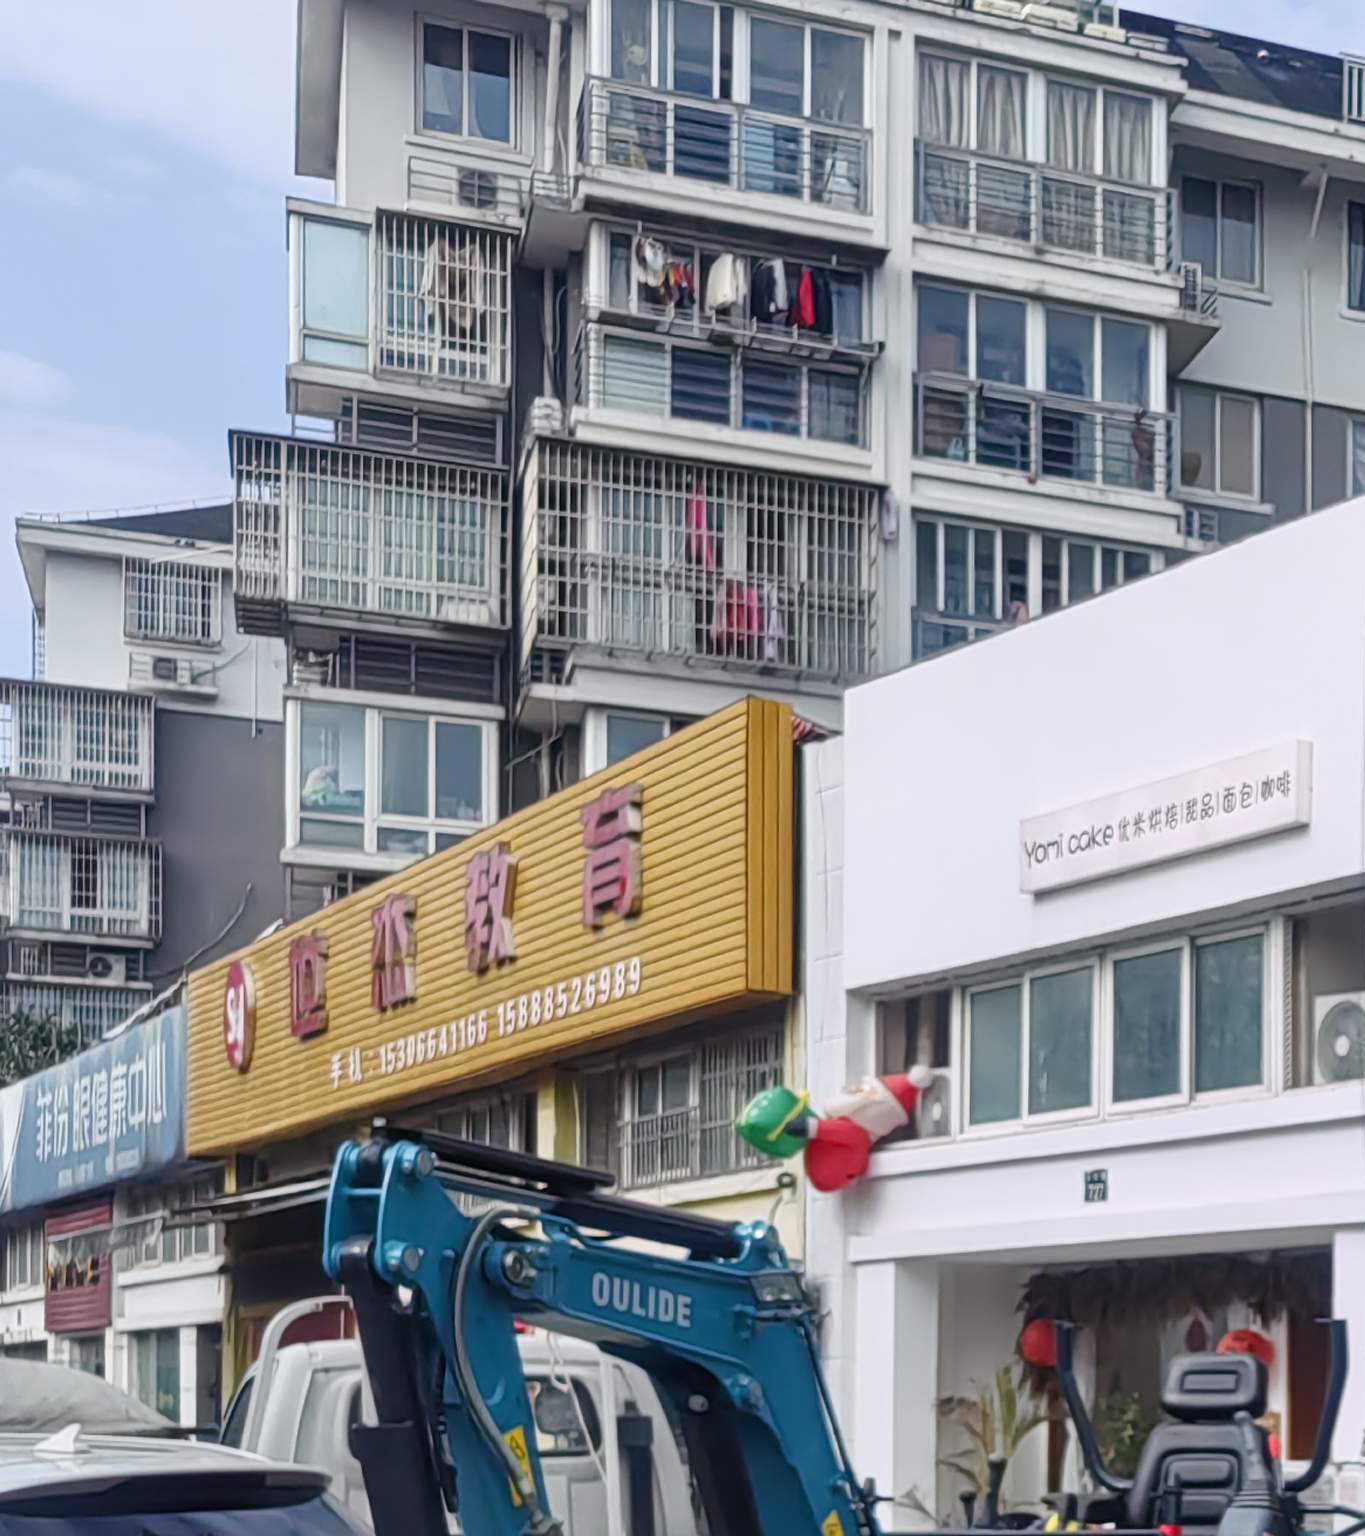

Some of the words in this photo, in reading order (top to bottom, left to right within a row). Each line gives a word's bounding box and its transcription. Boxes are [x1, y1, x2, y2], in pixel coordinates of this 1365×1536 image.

[1068, 824, 1114, 855] cake
[497, 956, 641, 1037] 15888526989
[592, 1272, 692, 1328] OULIDE
